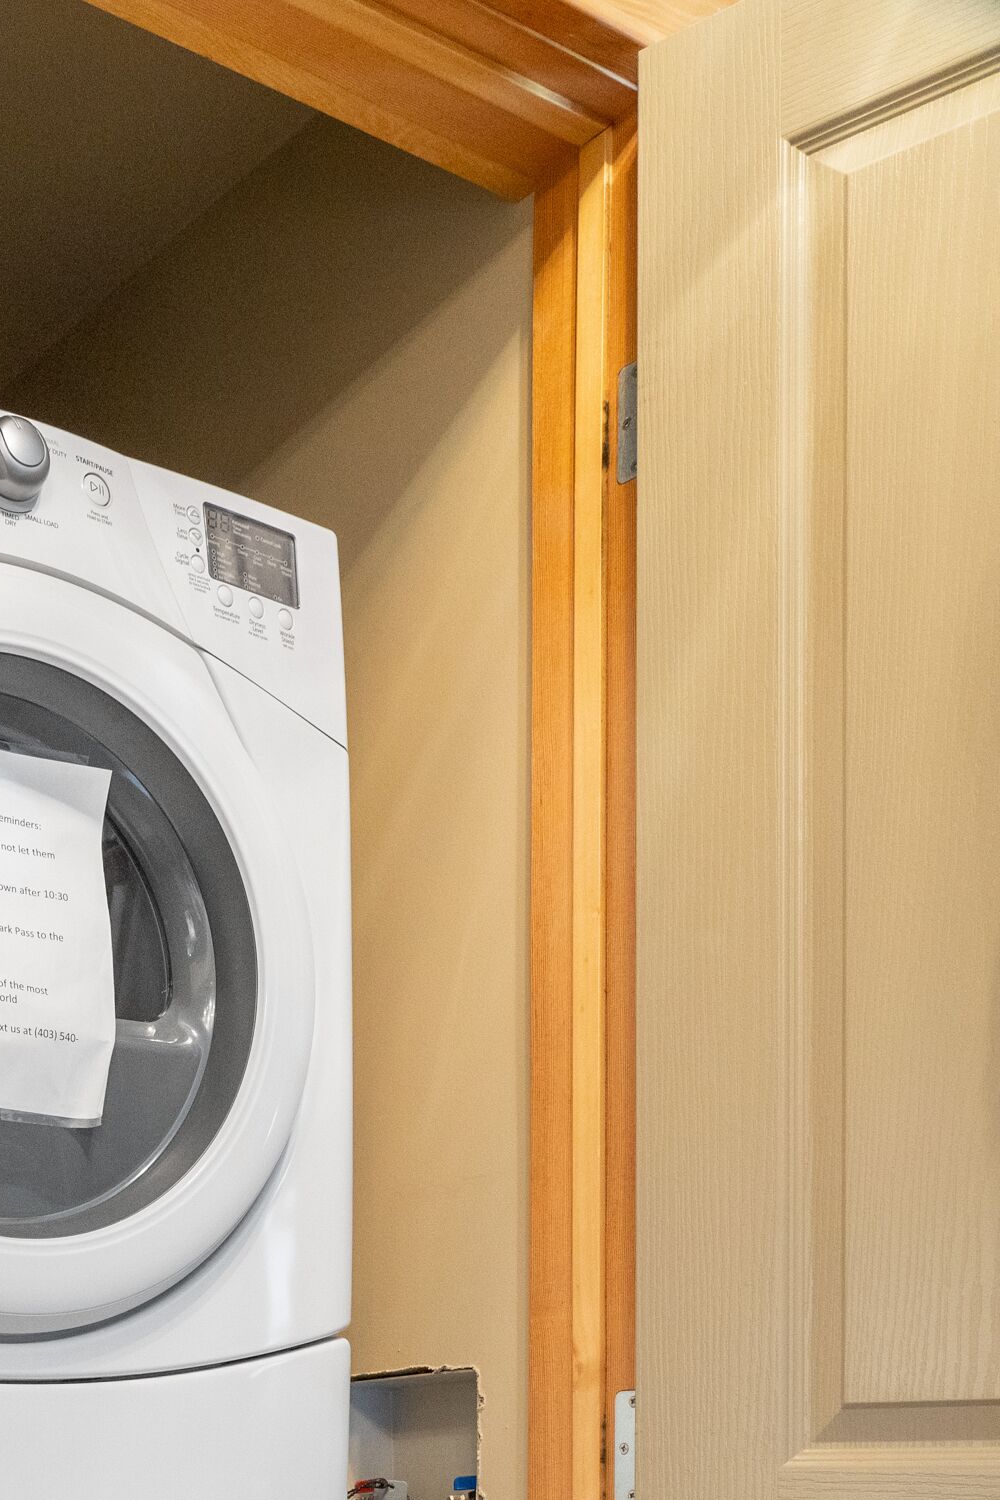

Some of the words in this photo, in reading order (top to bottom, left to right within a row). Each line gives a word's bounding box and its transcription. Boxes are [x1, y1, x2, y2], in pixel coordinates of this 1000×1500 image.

[52, 449, 67, 459] DUTY
[76, 455, 113, 476] START/PAUSE
[1, 511, 20, 520] TIMED
[5, 519, 16, 527] DRY
[24, 513, 42, 525] SMALL
[44, 518, 59, 529] LOAD
[0, 842, 16, 853] not
[18, 845, 30, 855] let
[32, 849, 55, 860] them
[19, 885, 41, 898] after
[44, 889, 69, 901] 10:30
[15, 927, 35, 938] Pass
[36, 932, 47, 940] to
[48, 932, 64, 942] the
[9, 981, 24, 992] the
[26, 985, 48, 996] most
[10, 1025, 21, 1035] us
[23, 1027, 32, 1036] at
[34, 1027, 58, 1041] (403)
[59, 1031, 79, 1043] 540-
